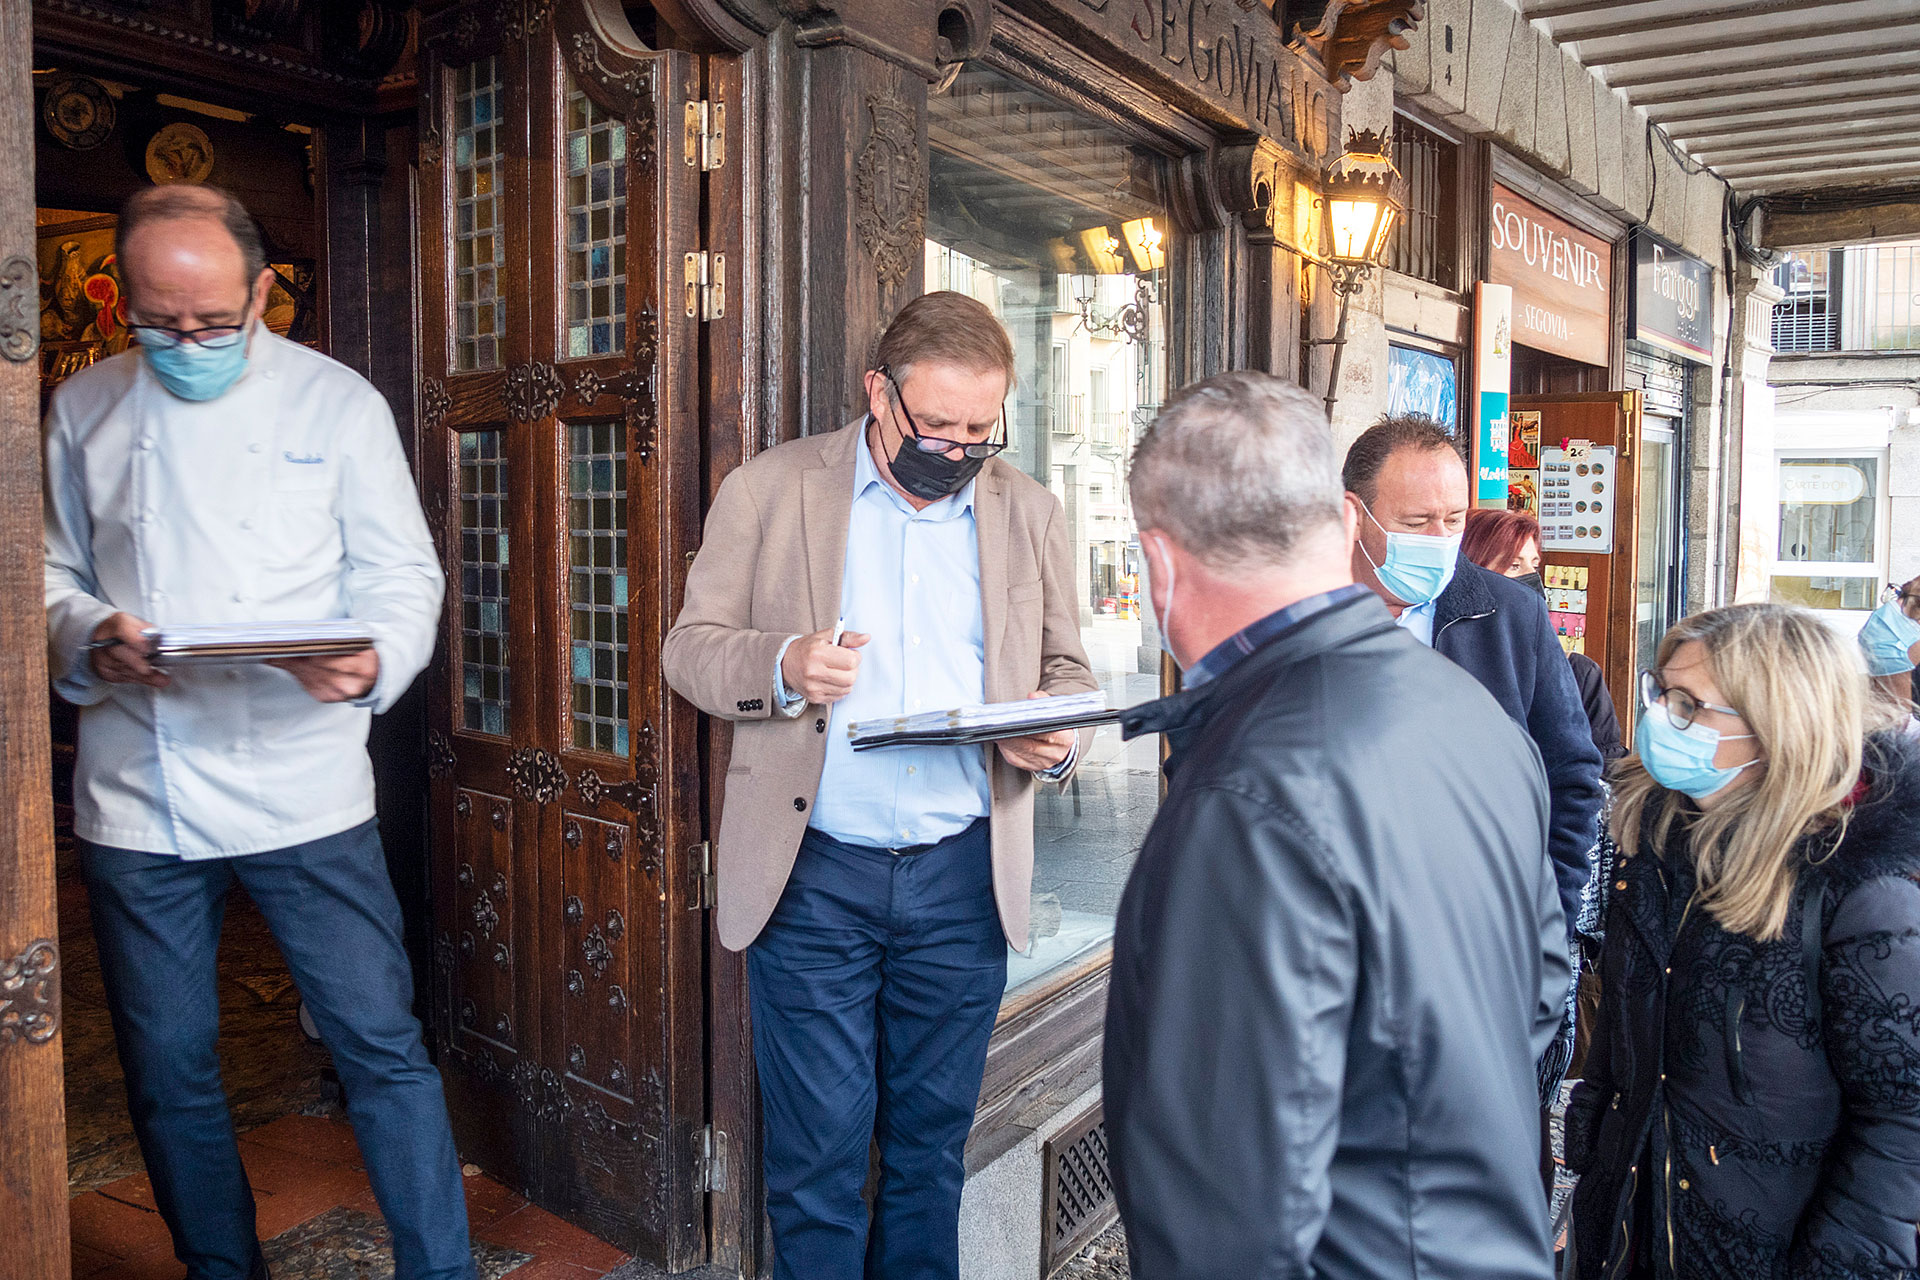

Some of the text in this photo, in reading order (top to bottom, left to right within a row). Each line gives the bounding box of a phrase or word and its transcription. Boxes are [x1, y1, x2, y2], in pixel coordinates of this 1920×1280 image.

[1492, 202, 1605, 291] SOUVENIR
[1653, 243, 1699, 321] Farggi
[1524, 304, 1568, 341] SEGOVIA
[1784, 480, 1848, 491] CARTE D'OR
